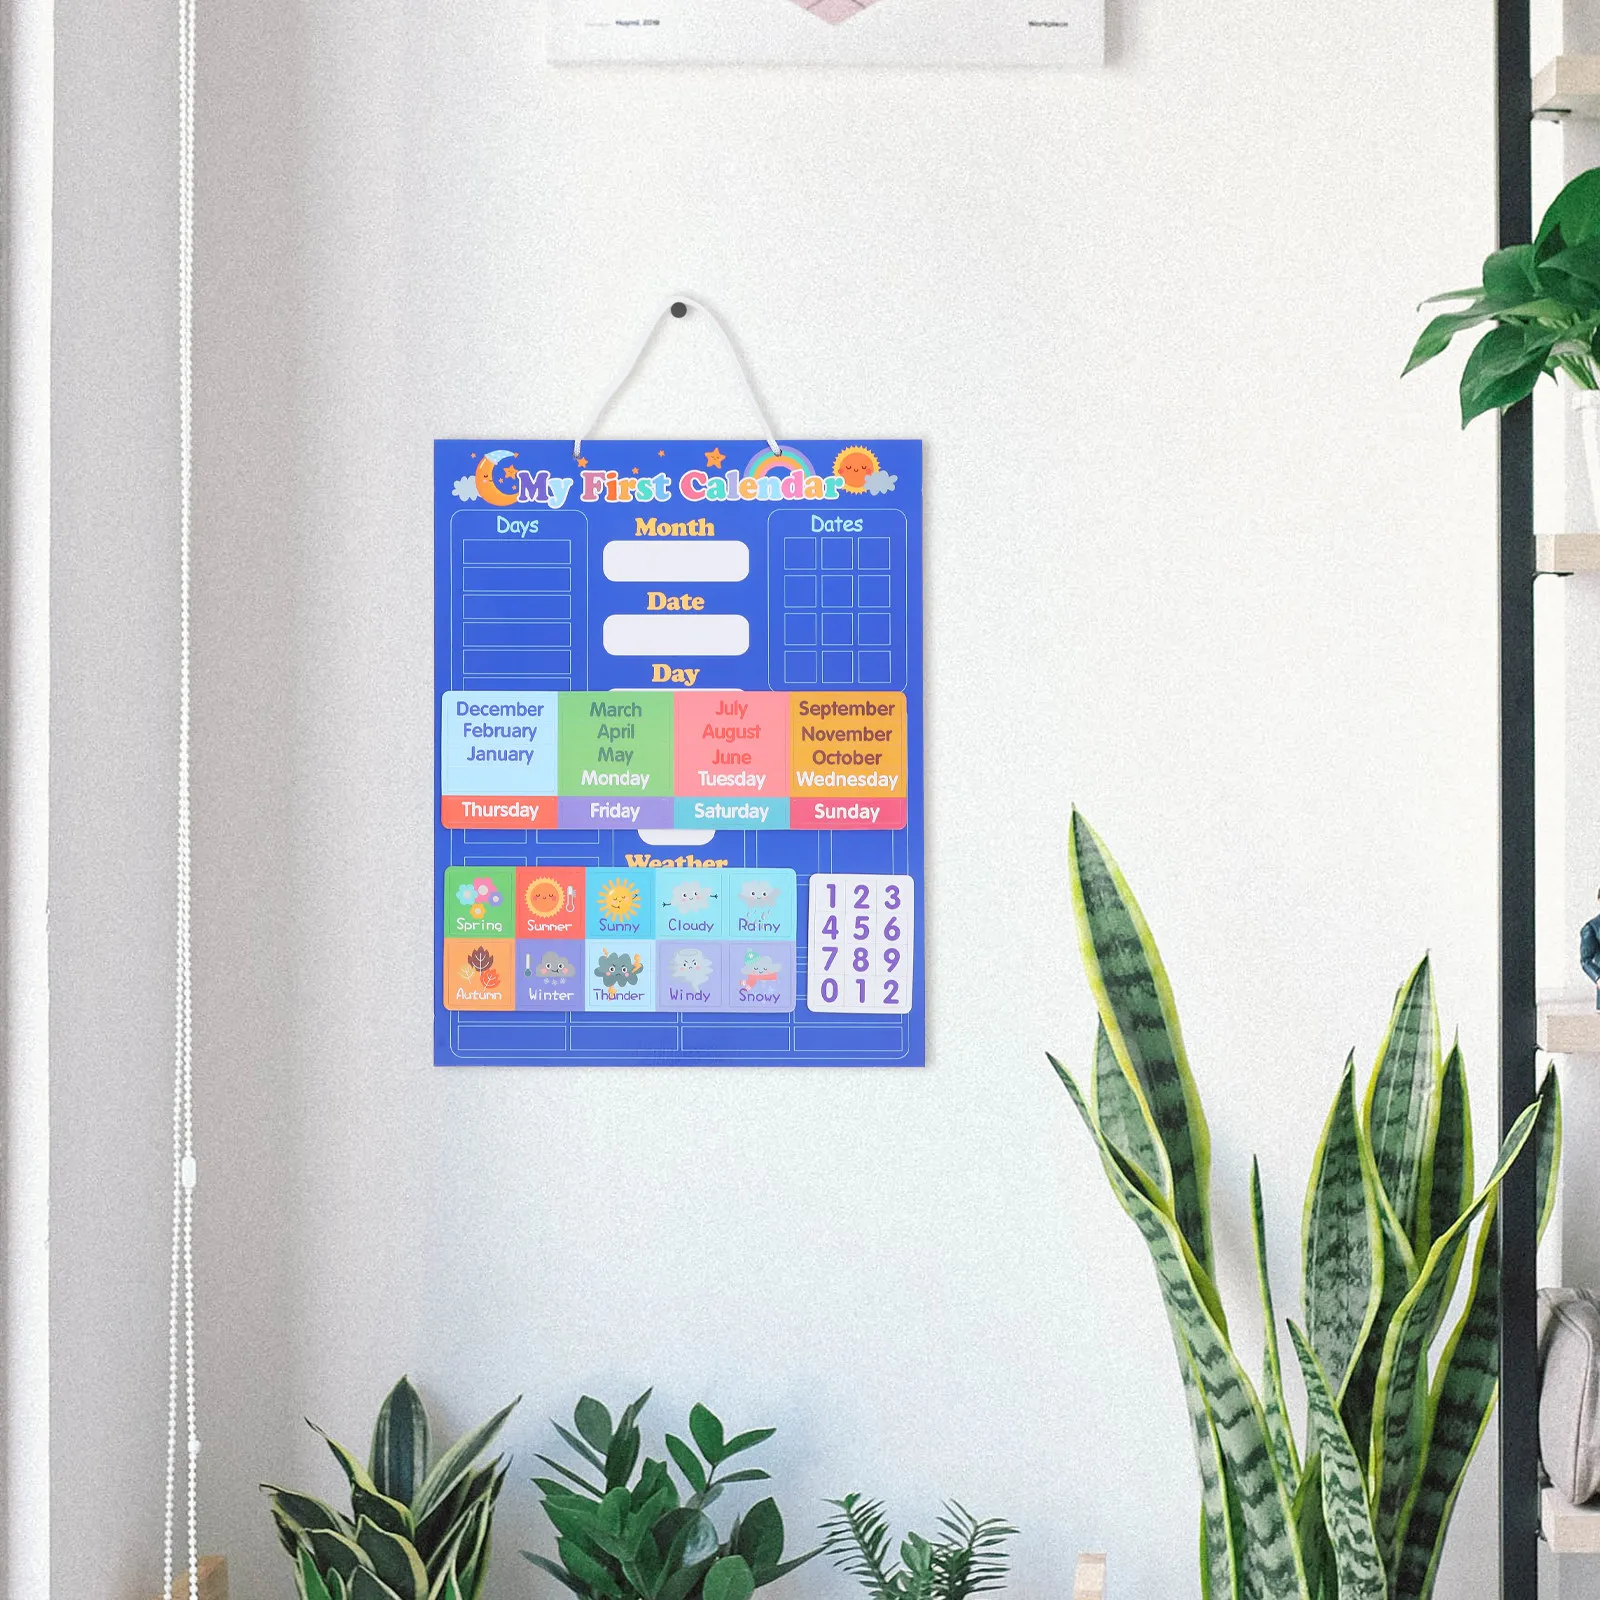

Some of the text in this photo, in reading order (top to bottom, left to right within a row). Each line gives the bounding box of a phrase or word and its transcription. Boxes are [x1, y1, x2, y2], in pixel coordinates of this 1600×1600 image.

[517, 470, 844, 509] My First Calendar
[496, 516, 539, 538] Days
[635, 518, 715, 537] Month
[811, 515, 863, 533] Dates
[646, 592, 705, 611] Date
[651, 664, 700, 685] Day
[456, 701, 544, 717] December
[590, 701, 642, 718] March
[715, 700, 748, 719] July
[799, 700, 895, 720] September
[463, 722, 537, 742] February
[597, 723, 635, 743] April
[702, 723, 761, 743] August
[801, 726, 892, 742] November
[466, 746, 534, 765] January
[598, 747, 634, 766] May
[712, 749, 752, 765] June
[812, 750, 882, 766] October
[581, 770, 650, 789] Monday
[698, 771, 766, 790] Tuesday
[796, 771, 898, 791] Wednesday
[462, 801, 539, 822] Thursday
[590, 802, 641, 822] Friday
[694, 802, 769, 822] Saturday
[814, 803, 880, 823] Sunday
[826, 883, 901, 910] 1 2 3
[456, 917, 502, 932] Spring
[527, 919, 573, 932] Summer
[599, 918, 640, 933] Sunny
[668, 918, 714, 933] Cloudy
[738, 918, 781, 933] Rainy
[821, 915, 901, 941] 4 5 6
[822, 946, 901, 973] 7 8 9
[456, 987, 502, 1001] Autumn
[528, 988, 574, 1001] Winter
[593, 988, 645, 1001] Thunder
[669, 987, 711, 1002] Windy
[739, 988, 781, 1004] Snowy
[820, 978, 900, 1004] 0 1 2
